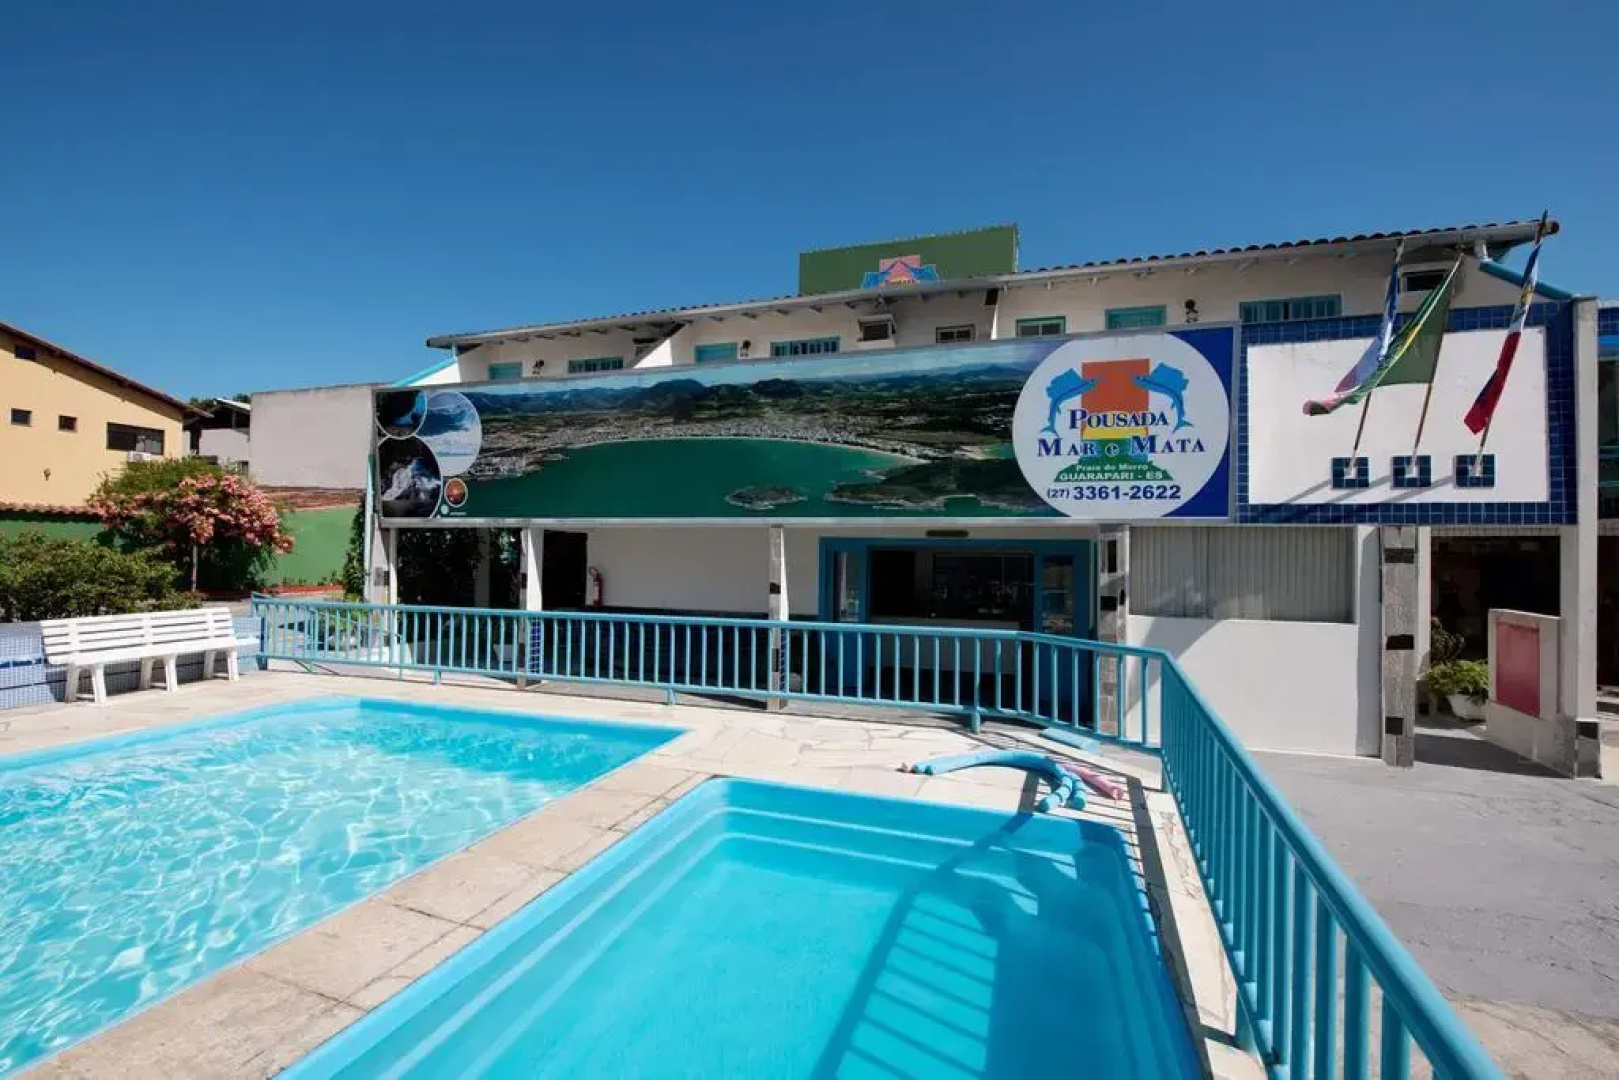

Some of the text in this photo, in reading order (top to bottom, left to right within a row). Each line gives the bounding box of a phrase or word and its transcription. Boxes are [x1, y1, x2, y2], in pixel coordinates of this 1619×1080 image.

[1068, 409, 1168, 429] POUSADA
[1037, 438, 1096, 457] MAR
[1130, 435, 1206, 454] MATA
[1059, 472, 1135, 480] GUARAPARI
[1146, 471, 1163, 480] ES
[1047, 485, 1182, 500] (27) 3361-2622
